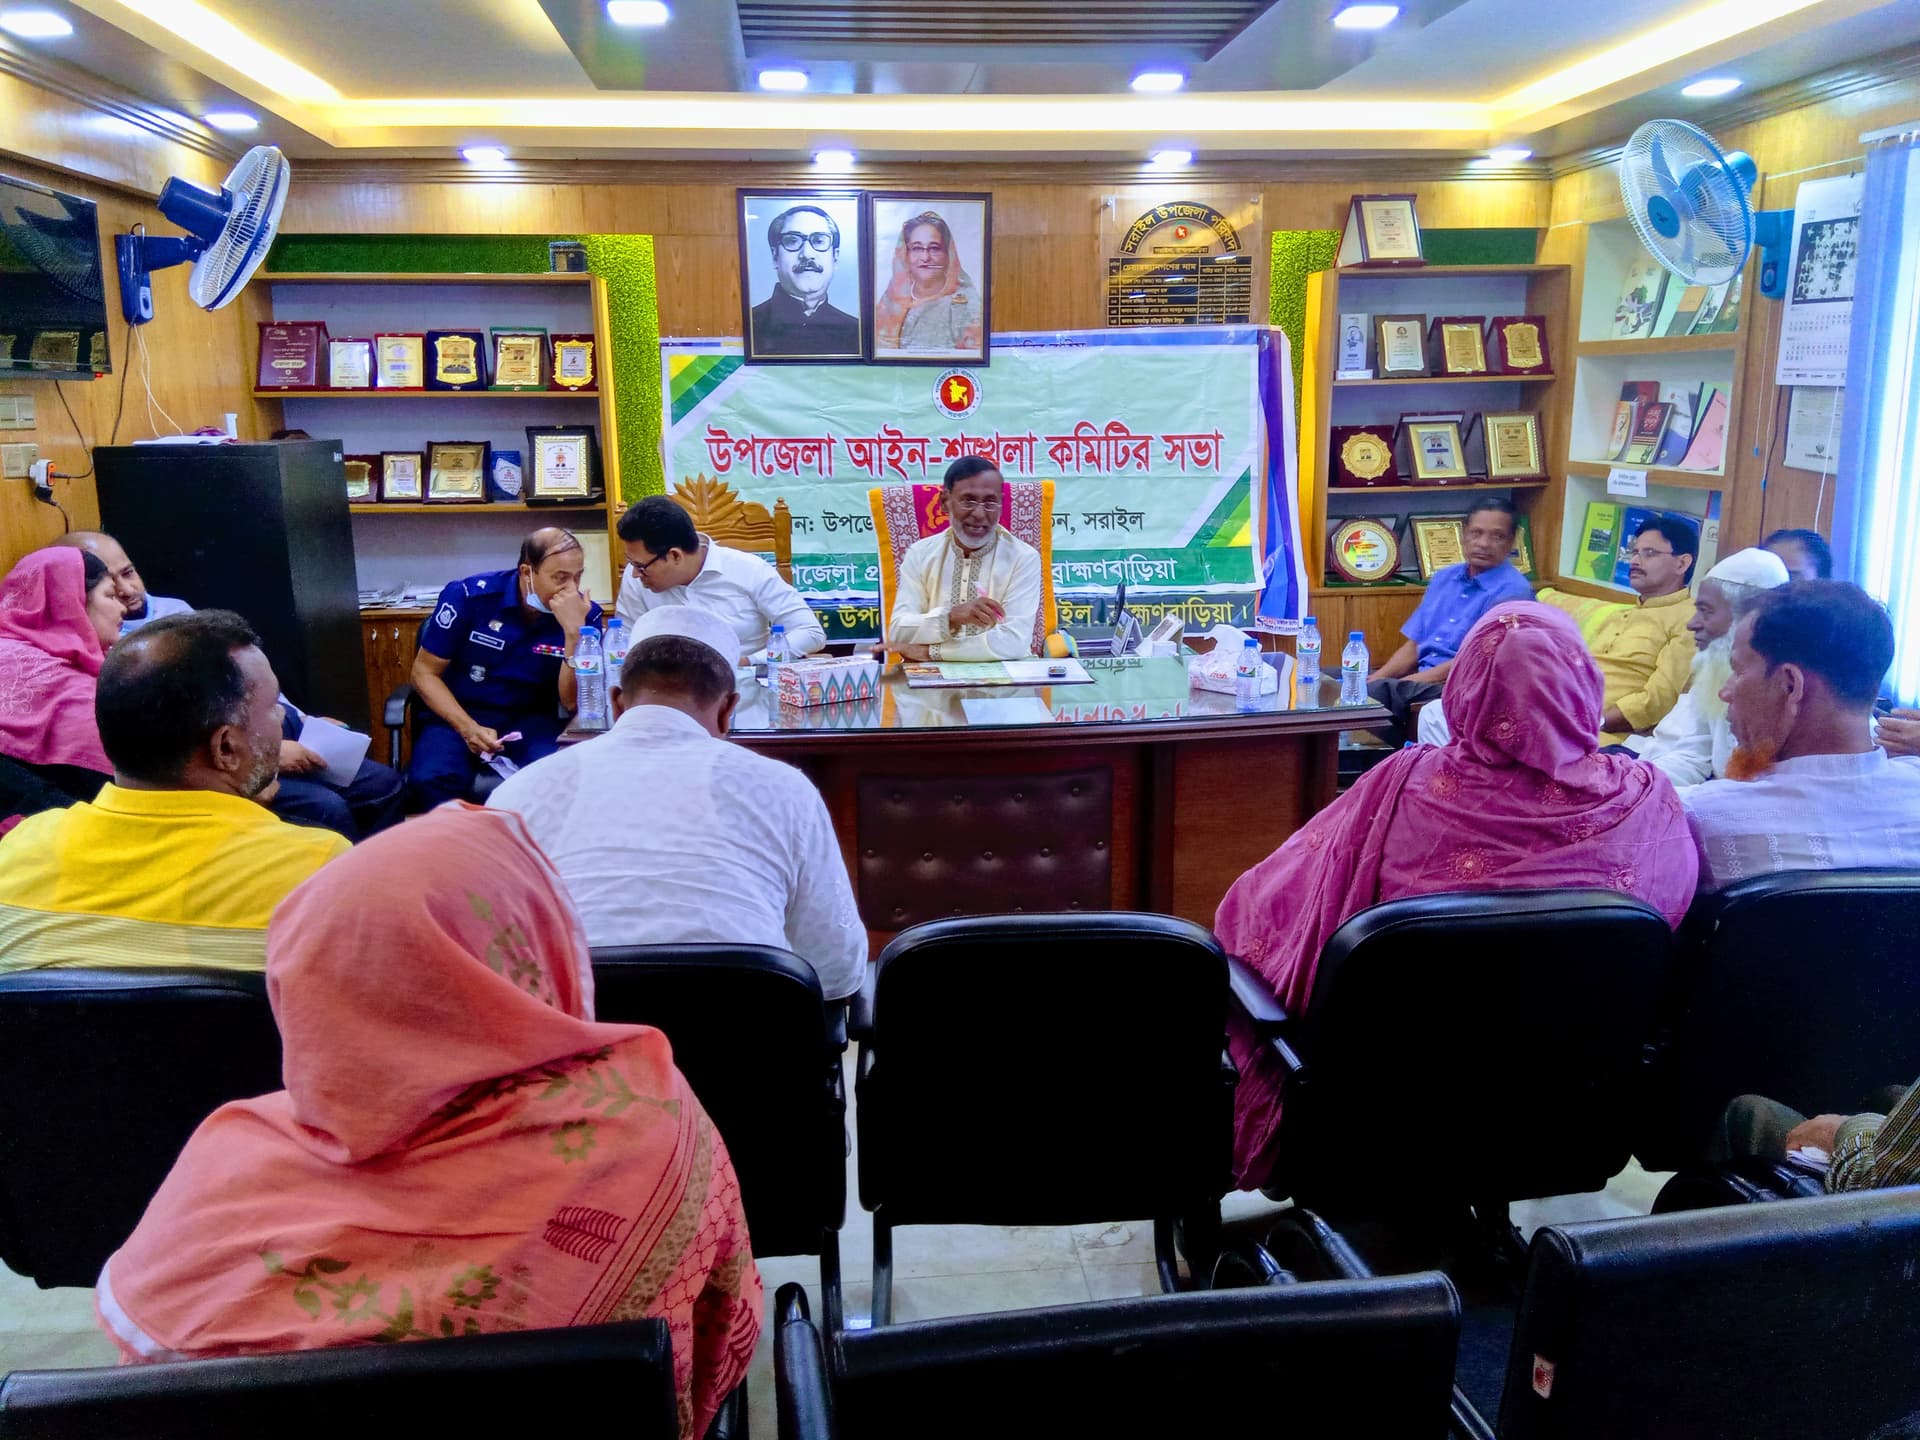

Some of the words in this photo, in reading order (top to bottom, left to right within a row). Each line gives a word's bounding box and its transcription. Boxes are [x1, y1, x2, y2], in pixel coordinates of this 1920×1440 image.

[1156, 204, 1209, 221] উপজেলা
[703, 423, 837, 477] উপজেলা
[843, 423, 1039, 481] আইন-শঙ্খলা
[1044, 420, 1154, 474] কমিটির
[1161, 429, 1225, 473] সভা
[1081, 506, 1145, 533] সরাইল
